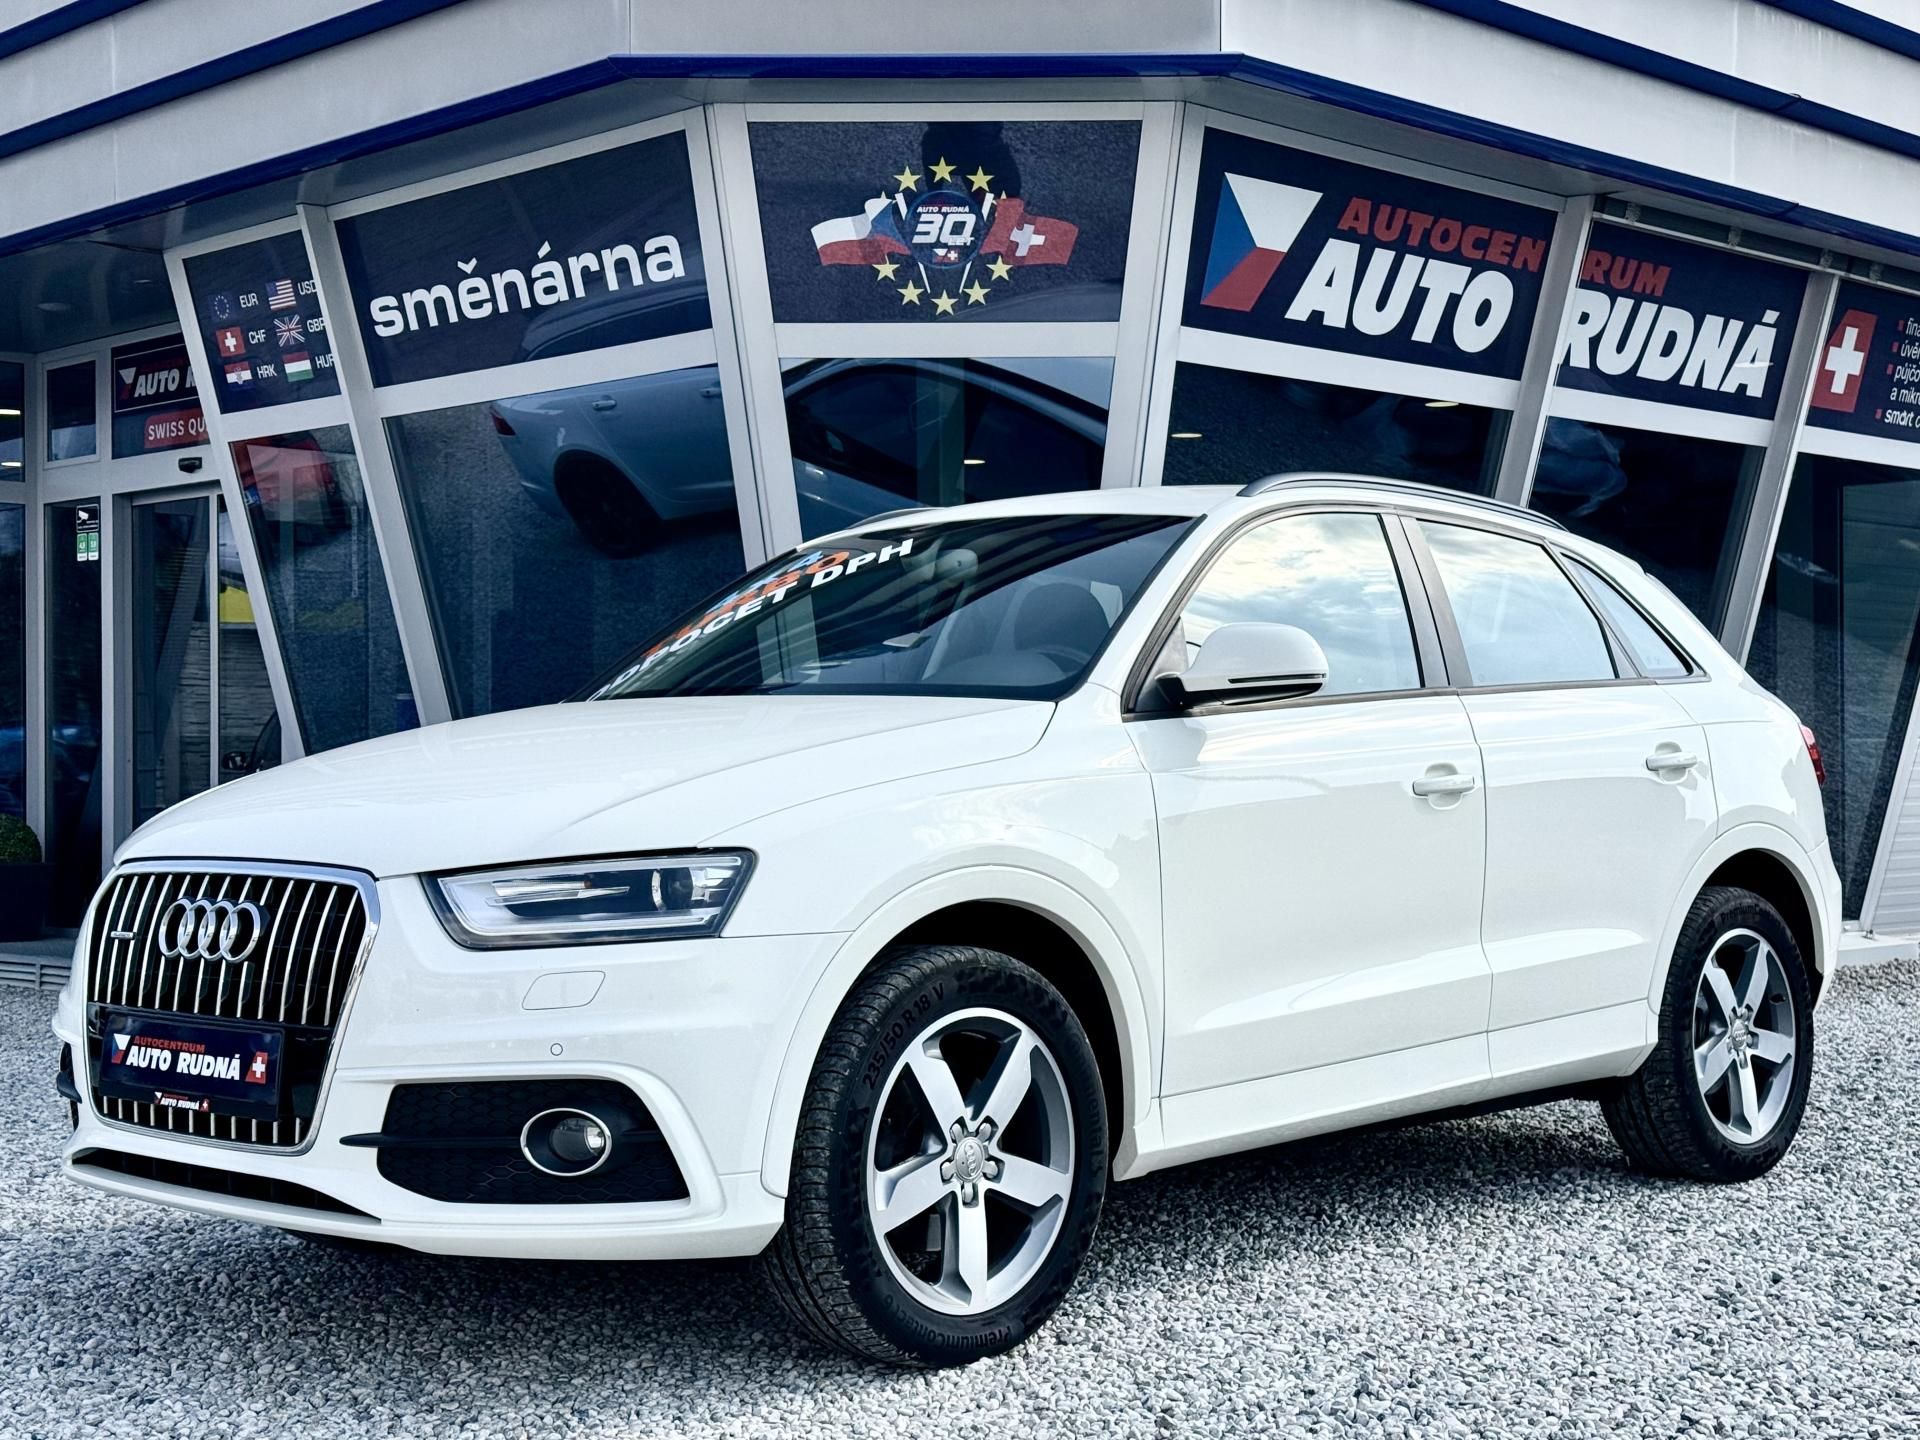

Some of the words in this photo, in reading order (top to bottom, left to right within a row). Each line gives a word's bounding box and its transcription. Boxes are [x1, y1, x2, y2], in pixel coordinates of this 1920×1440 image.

[911, 213, 977, 243] 30
[1337, 197, 1547, 272] AUTOCEN
[1581, 249, 1672, 297] RUM
[297, 280, 318, 296] USD
[369, 234, 686, 338] směnárna
[239, 293, 259, 309] EUR
[1284, 238, 1514, 353] AUTO
[1561, 288, 1780, 398] RUDNÁ
[248, 329, 267, 345] CHF
[134, 368, 180, 397] AUTO
[256, 363, 278, 379] HRK
[1890, 387, 1898, 401] a
[148, 420, 185, 440] SWISS
[188, 416, 208, 435] QU
[811, 538, 913, 588] DPH
[133, 1035, 206, 1054] AUTOCENTRUM
[863, 1023, 904, 1090] 235/50
[901, 1009, 915, 1026] R
[914, 994, 931, 1014] 18
[932, 982, 944, 1001] V
[126, 1045, 172, 1072] AUTO
[176, 1053, 241, 1081] RUDNÁ
[160, 1097, 177, 1107] AUTO
[177, 1100, 200, 1111] RUDNÁ
